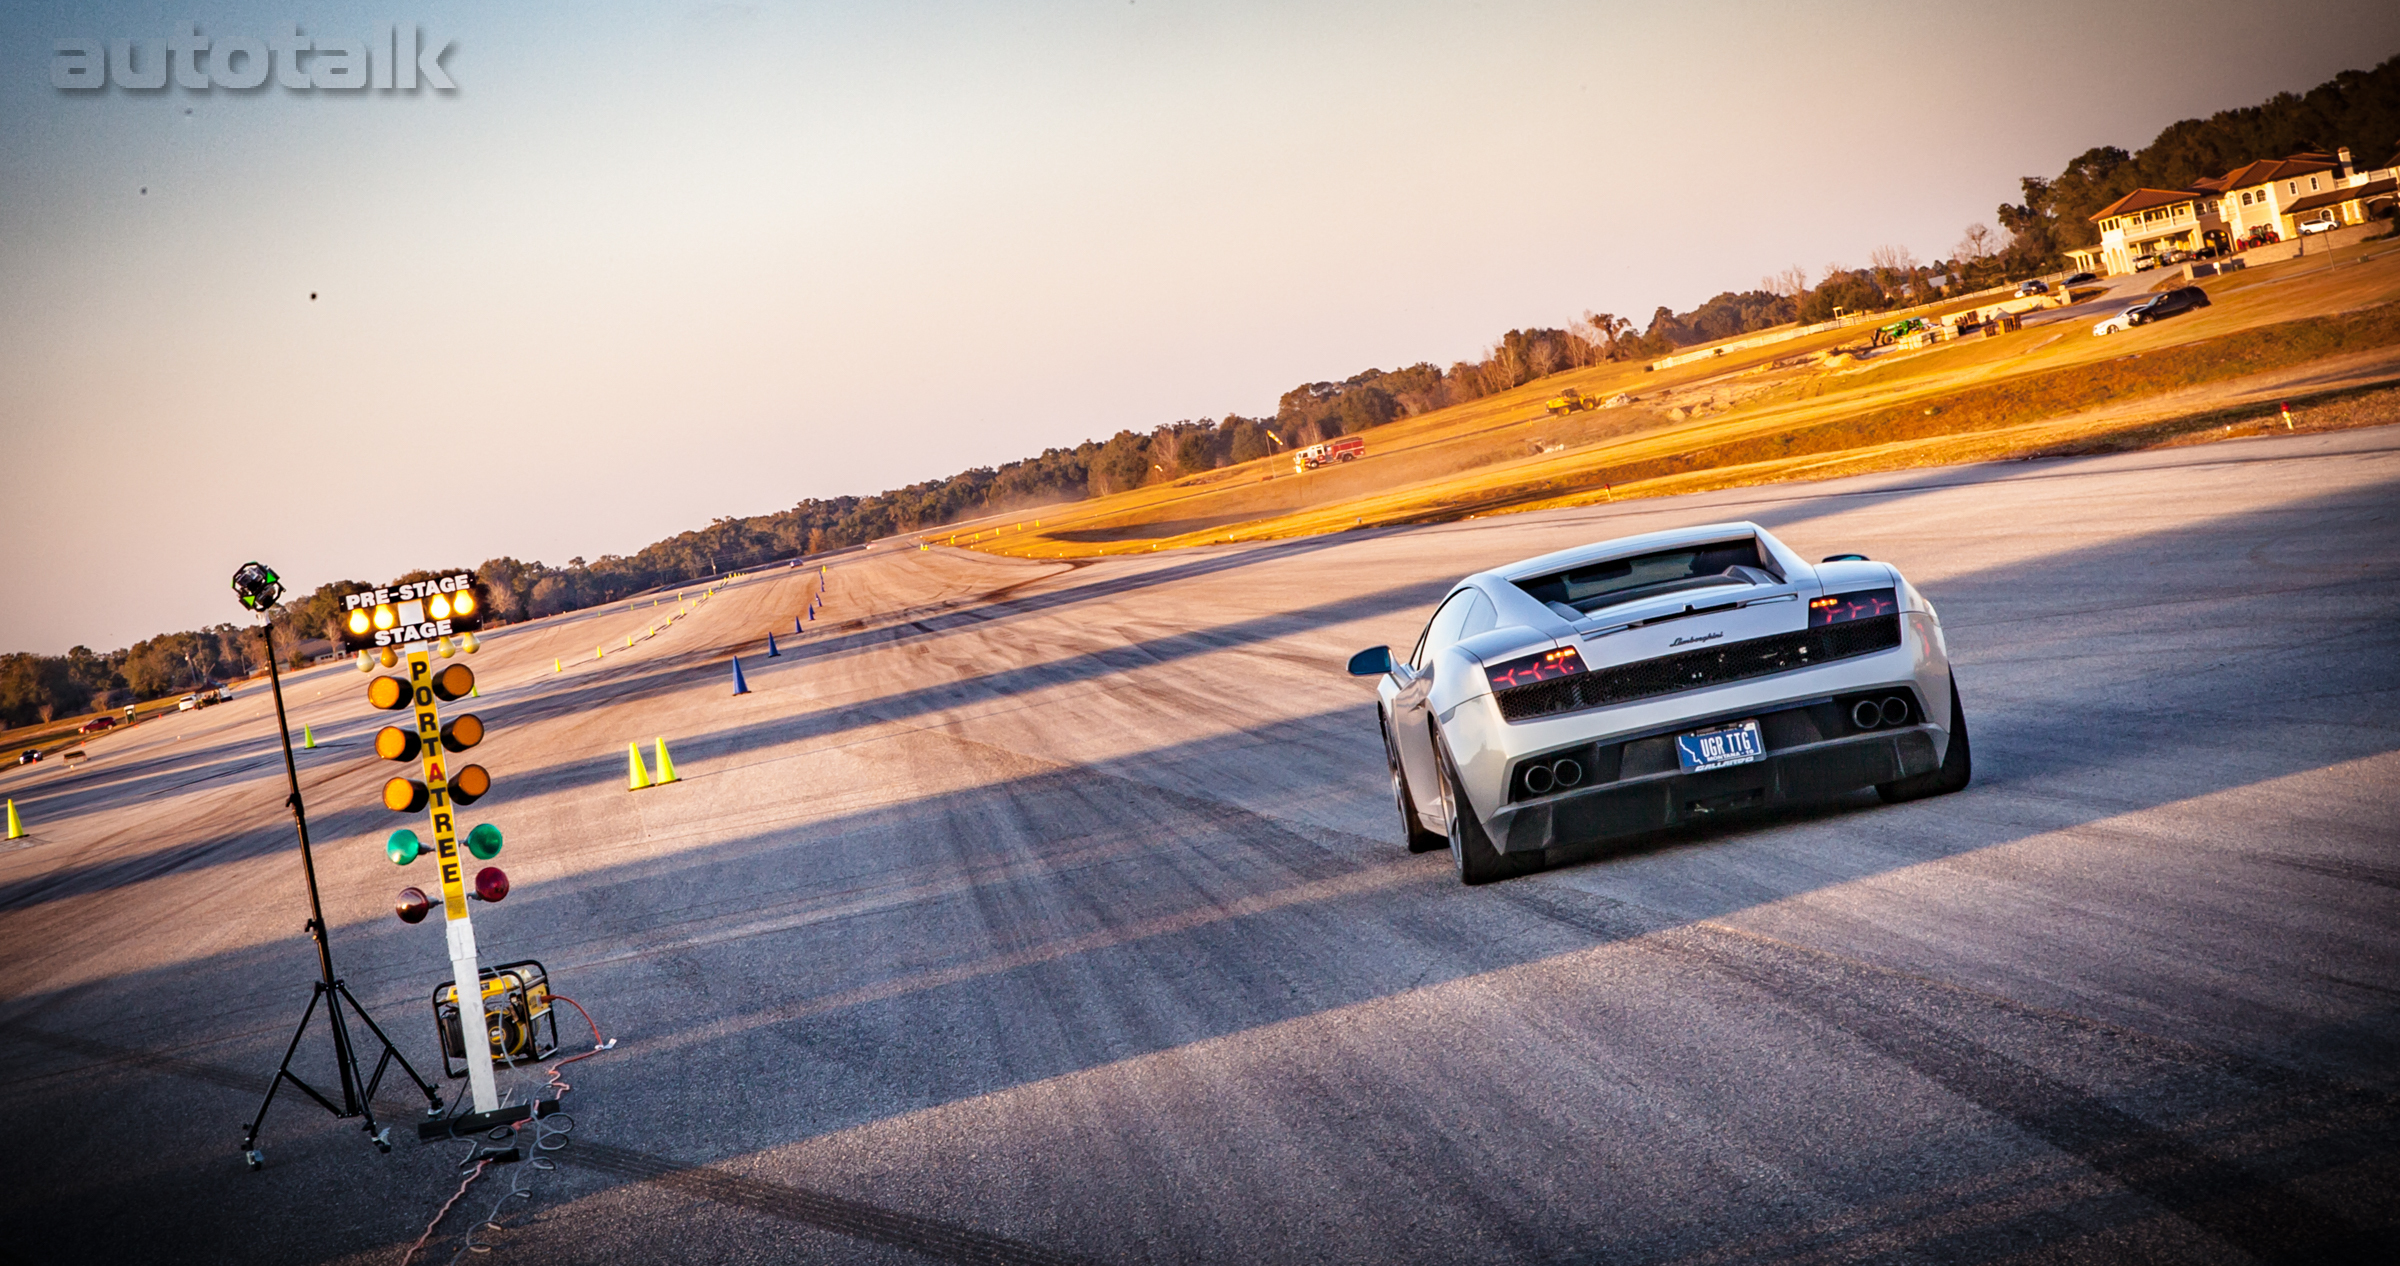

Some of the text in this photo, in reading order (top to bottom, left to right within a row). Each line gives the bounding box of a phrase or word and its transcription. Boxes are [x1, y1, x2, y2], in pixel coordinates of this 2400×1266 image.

[345, 574, 470, 611] PRE-STAGE
[374, 619, 453, 647] STAGE
[1669, 631, 1724, 648] Lamborghini
[1700, 731, 1752, 758] UGR TTG
[1706, 751, 1741, 762] MONTANA
[411, 661, 460, 884] PORTATREE
